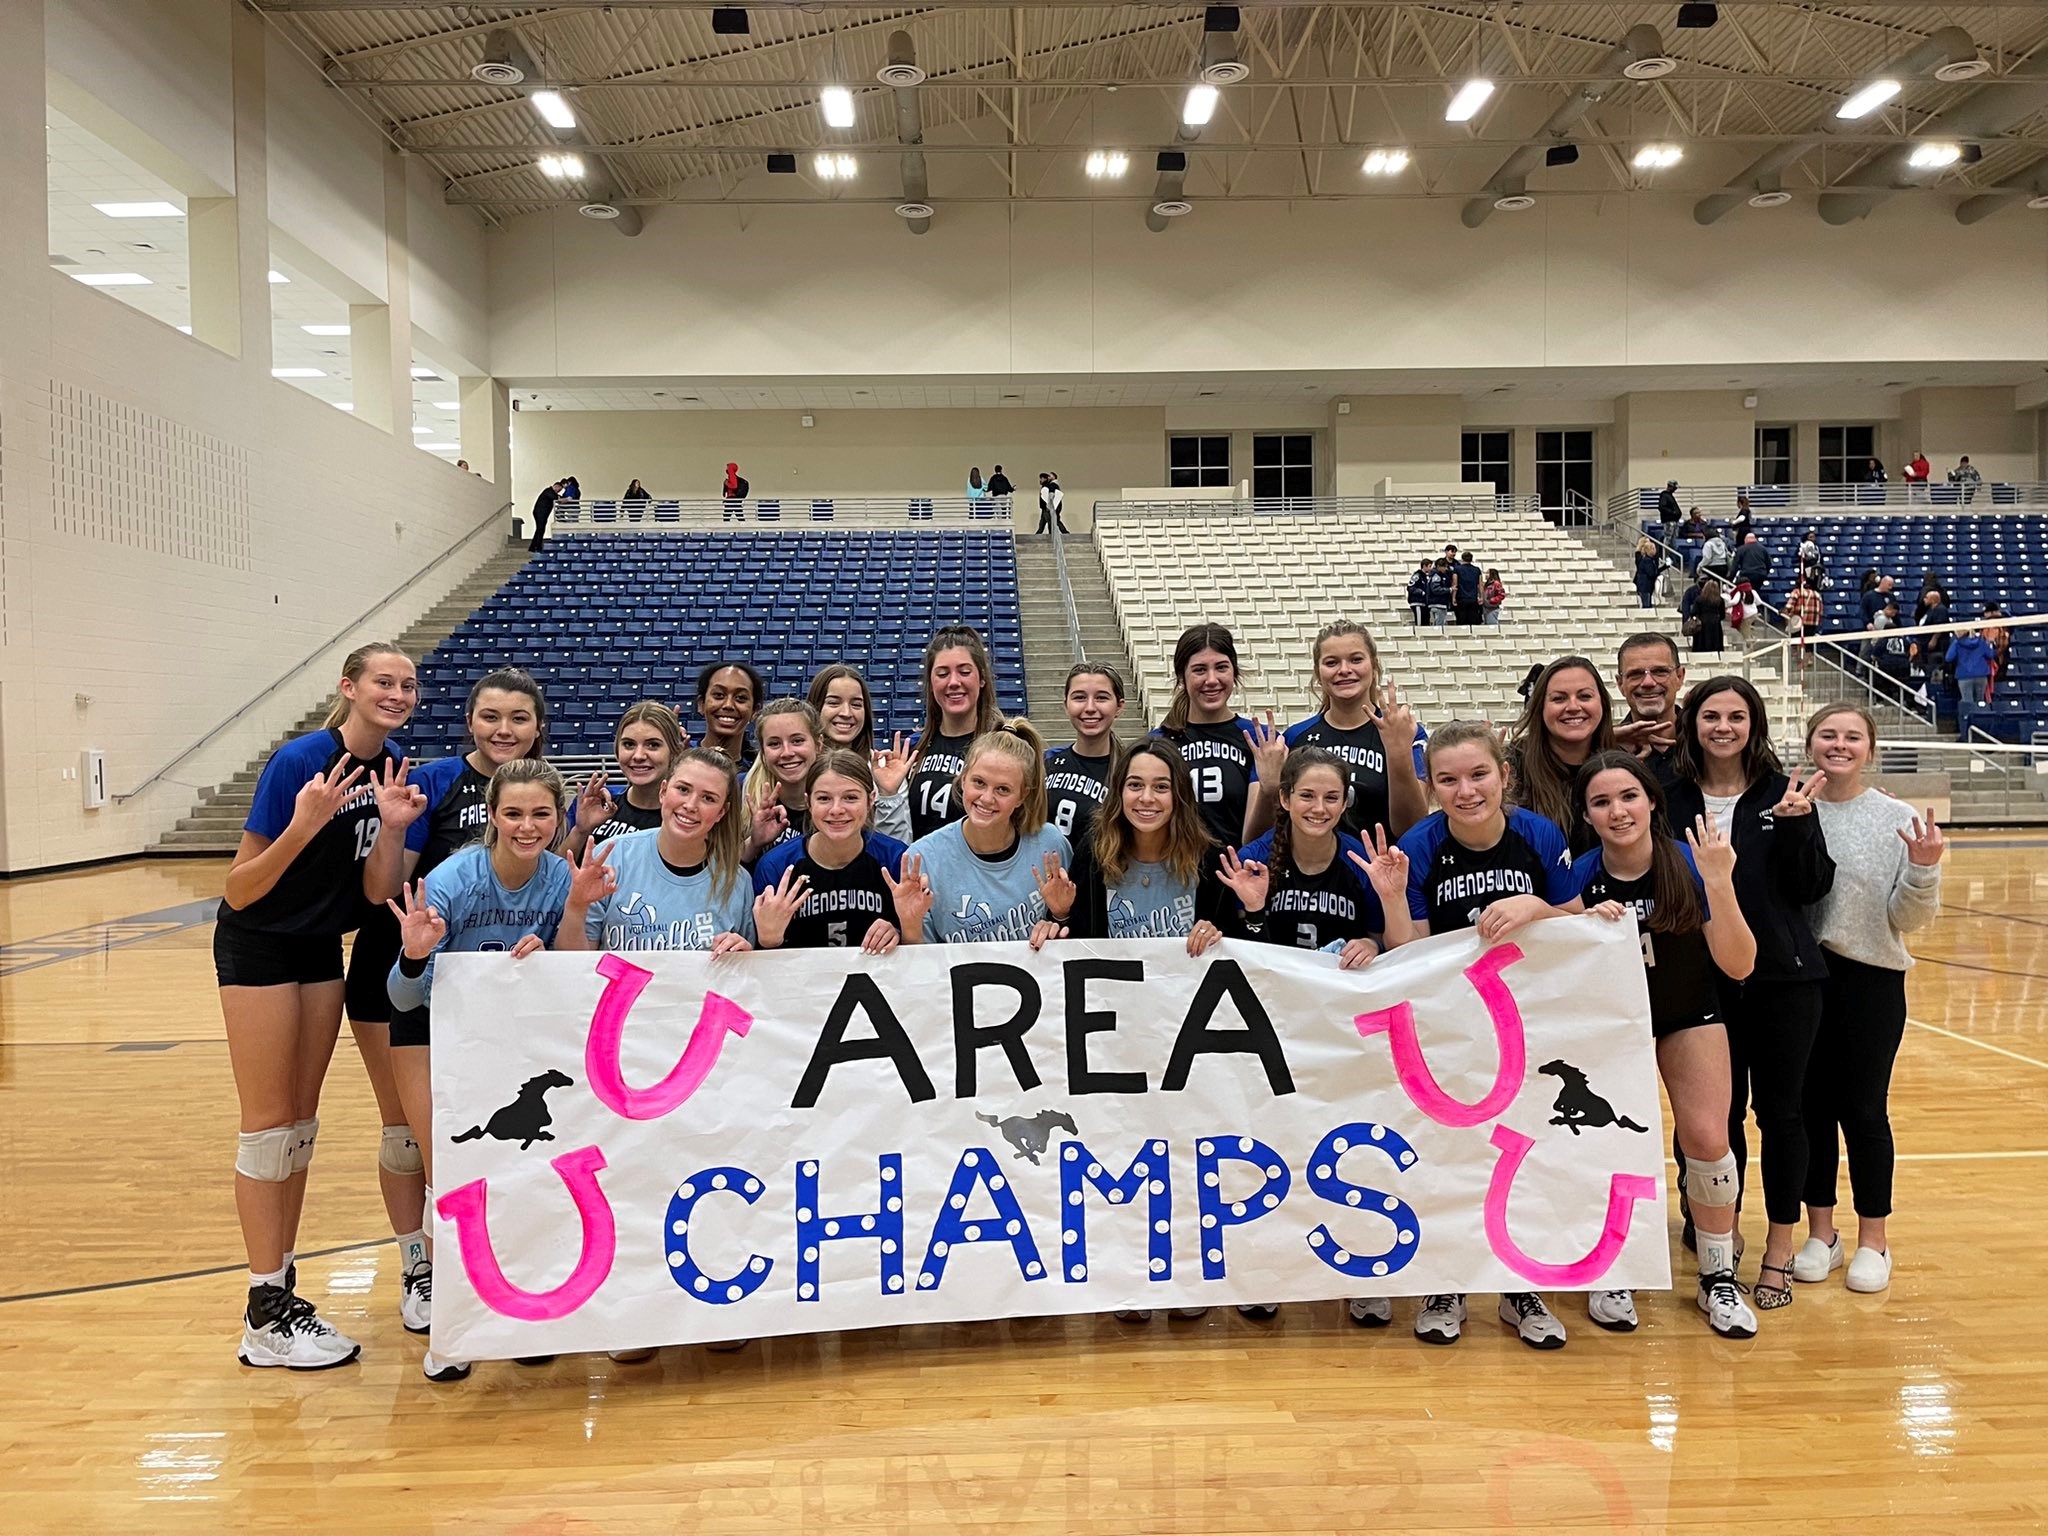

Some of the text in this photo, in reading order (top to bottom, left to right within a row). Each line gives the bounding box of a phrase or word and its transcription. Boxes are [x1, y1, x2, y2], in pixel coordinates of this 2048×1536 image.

[920, 780, 952, 819] 14
[1189, 766, 1224, 803] 13
[1054, 798, 1077, 836] 8
[794, 889, 883, 919] RIENDSWOOD
[1436, 869, 1534, 906] FRIENDSWOOD
[828, 921, 848, 947] 5
[791, 959, 1296, 1108] AREA
[665, 1122, 1420, 1305] CHAMPS
